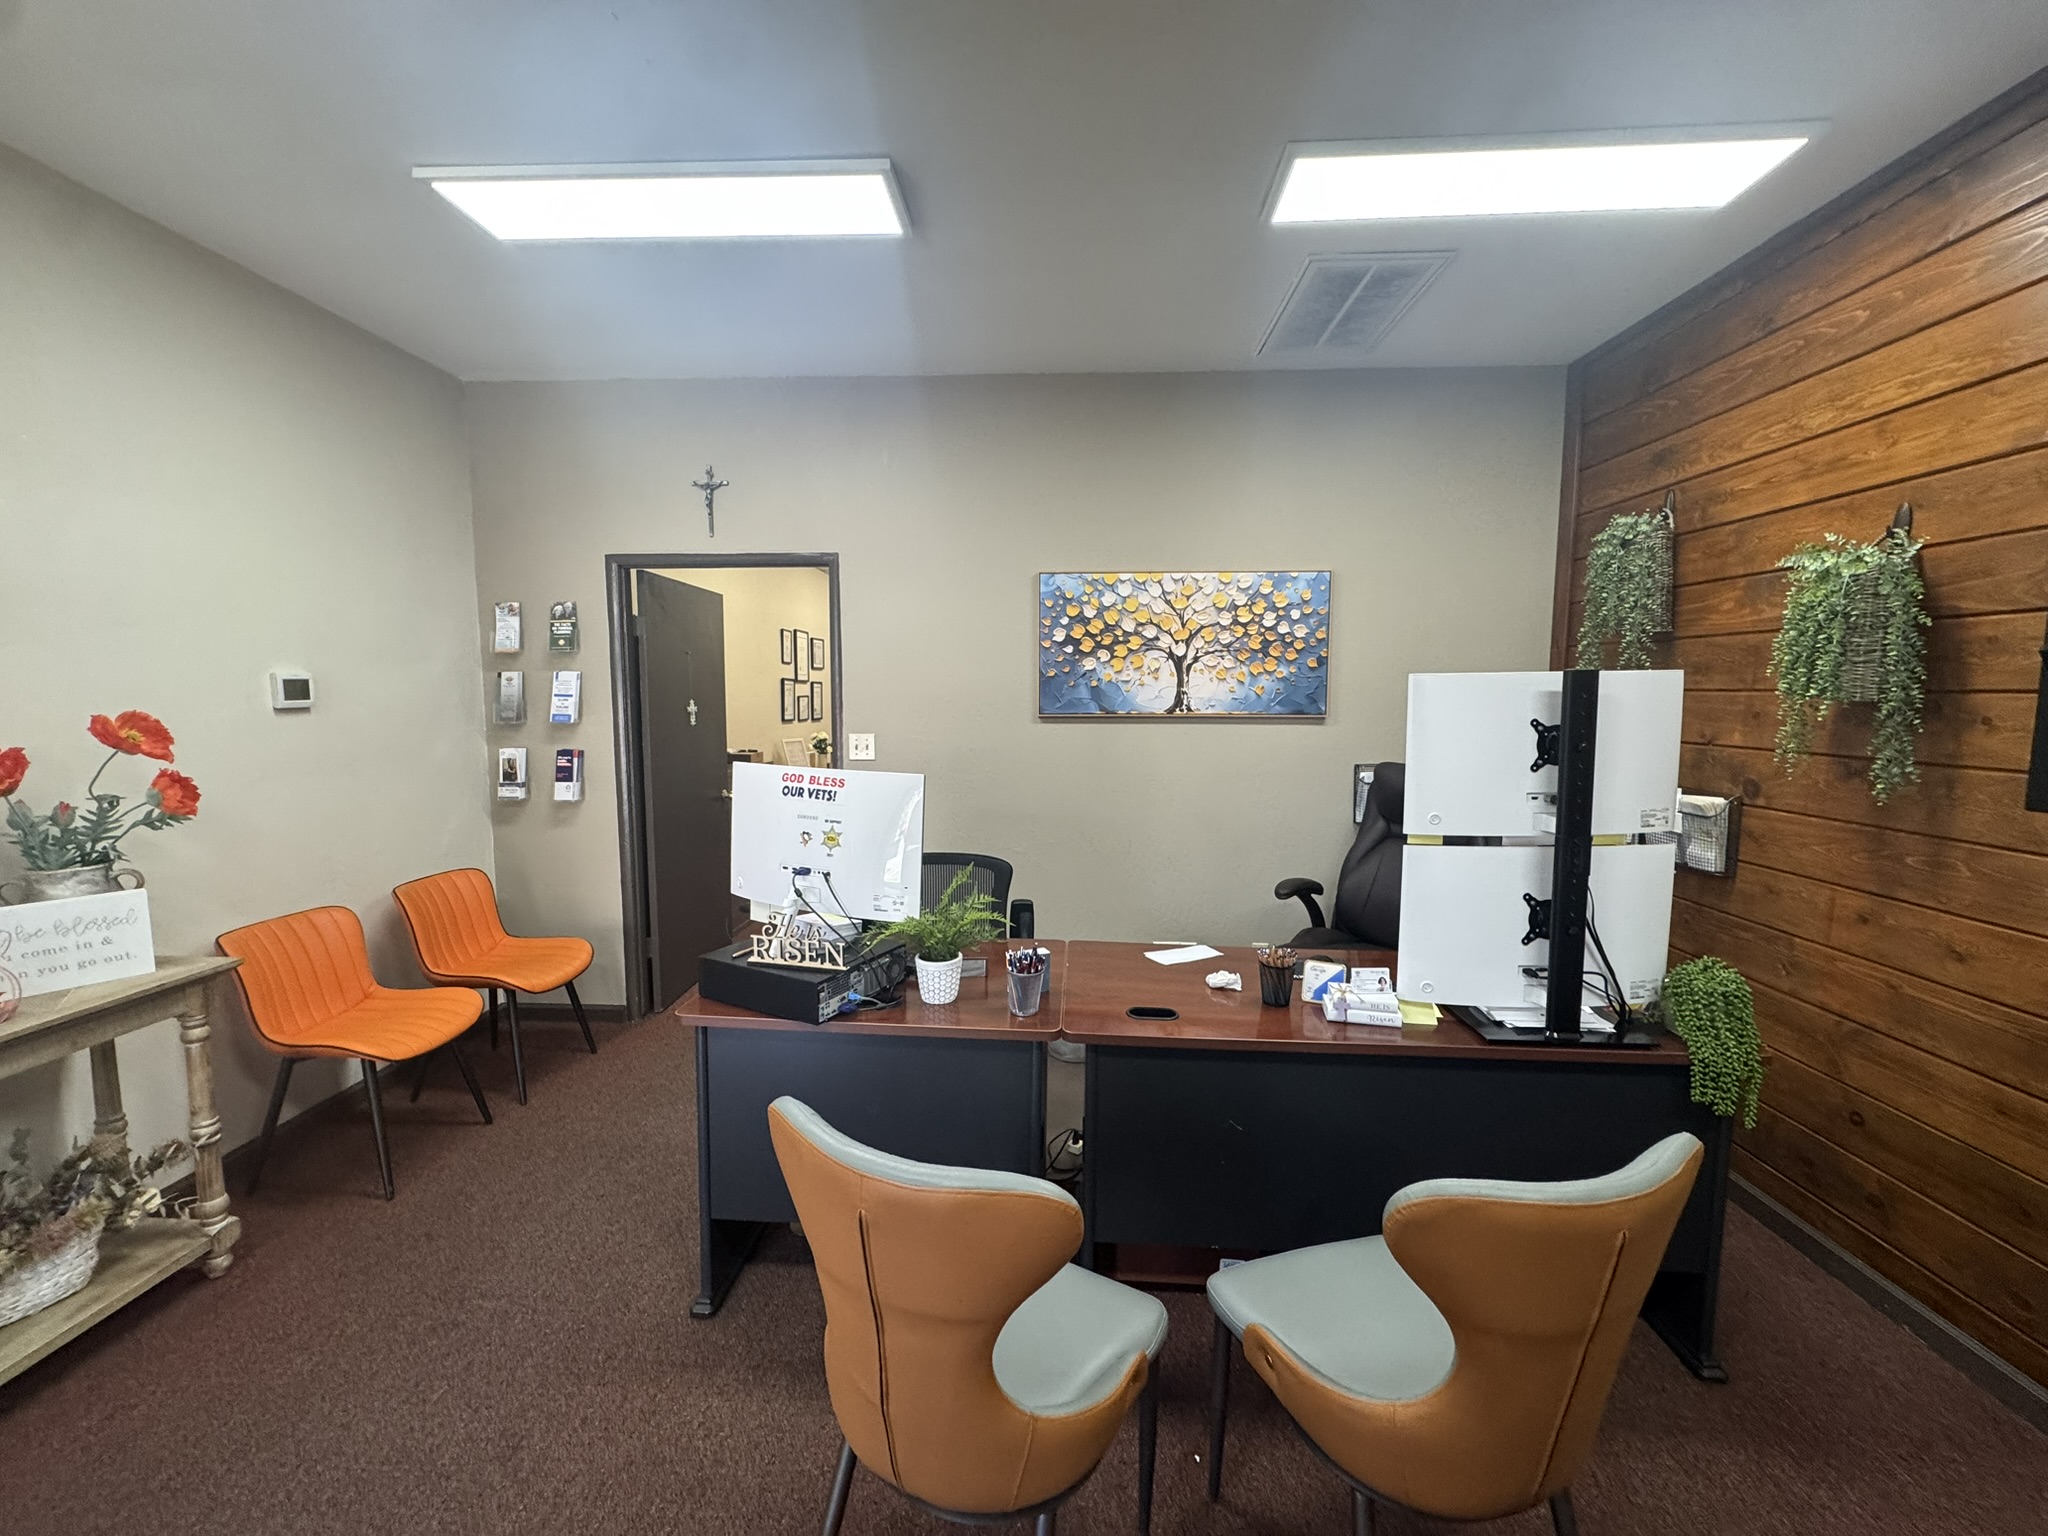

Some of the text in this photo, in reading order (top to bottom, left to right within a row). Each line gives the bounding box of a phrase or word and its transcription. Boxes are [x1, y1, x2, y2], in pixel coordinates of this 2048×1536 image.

[782, 772, 846, 789] GOD BLESS
[782, 785, 837, 802] OUR VETS!
[762, 911, 804, 940] He
[21, 943, 68, 960] come
[76, 940, 93, 951] in
[101, 935, 114, 946] &
[750, 934, 846, 968] RISEN
[37, 962, 69, 978] you
[77, 958, 97, 971] go
[103, 951, 138, 964] out.
[1370, 1002, 1381, 1010] HE
[1367, 1014, 1396, 1024] Risen
